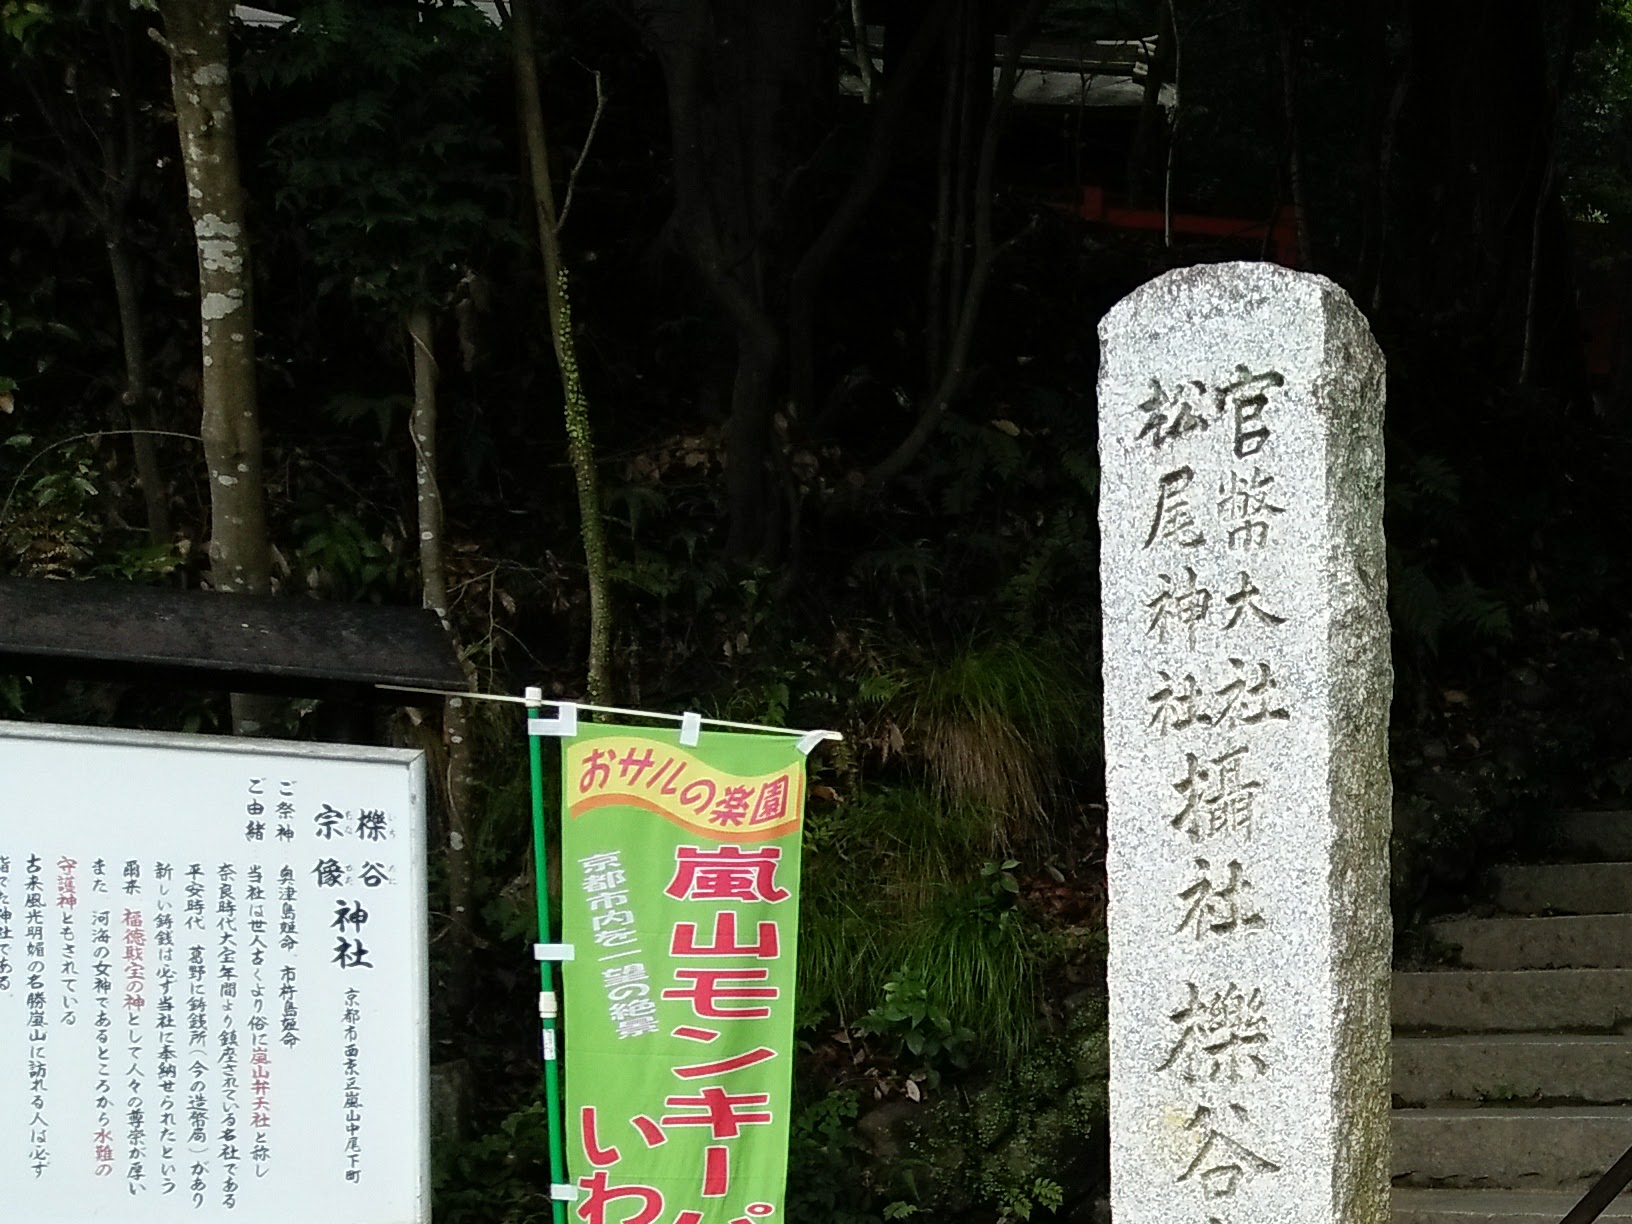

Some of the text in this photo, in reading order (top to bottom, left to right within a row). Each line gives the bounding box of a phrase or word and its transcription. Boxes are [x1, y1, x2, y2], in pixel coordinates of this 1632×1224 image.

[1134, 377, 1213, 737] 松尾神社
[579, 746, 790, 828] おサルの楽園
[310, 803, 345, 888] 宗像
[330, 900, 374, 969] 神社
